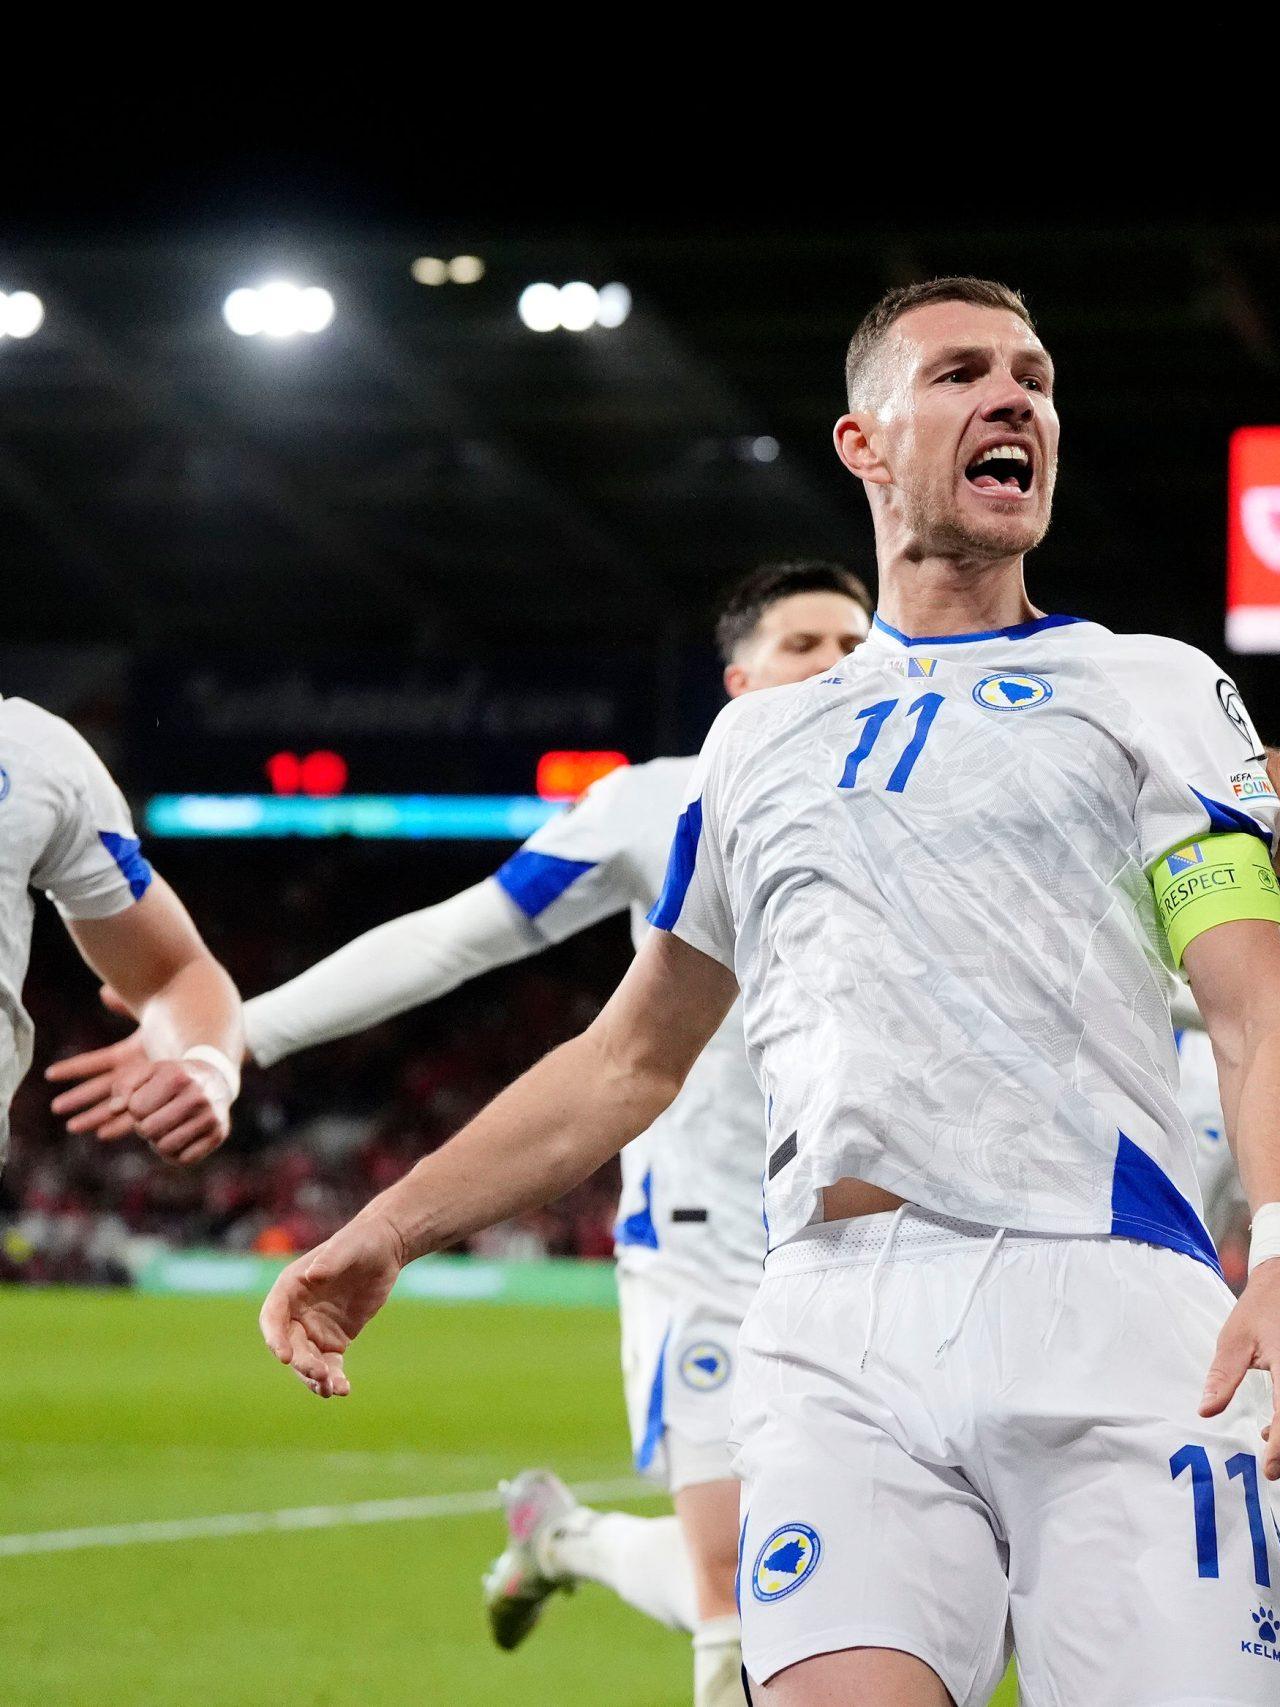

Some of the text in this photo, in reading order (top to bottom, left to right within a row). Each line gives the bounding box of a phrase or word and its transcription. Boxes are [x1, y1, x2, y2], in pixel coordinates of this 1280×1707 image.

[837, 692, 946, 793] 11
[1230, 772, 1252, 783] UEFA
[1164, 868, 1235, 915] RESPECT
[1169, 1444, 1271, 1588] 11
